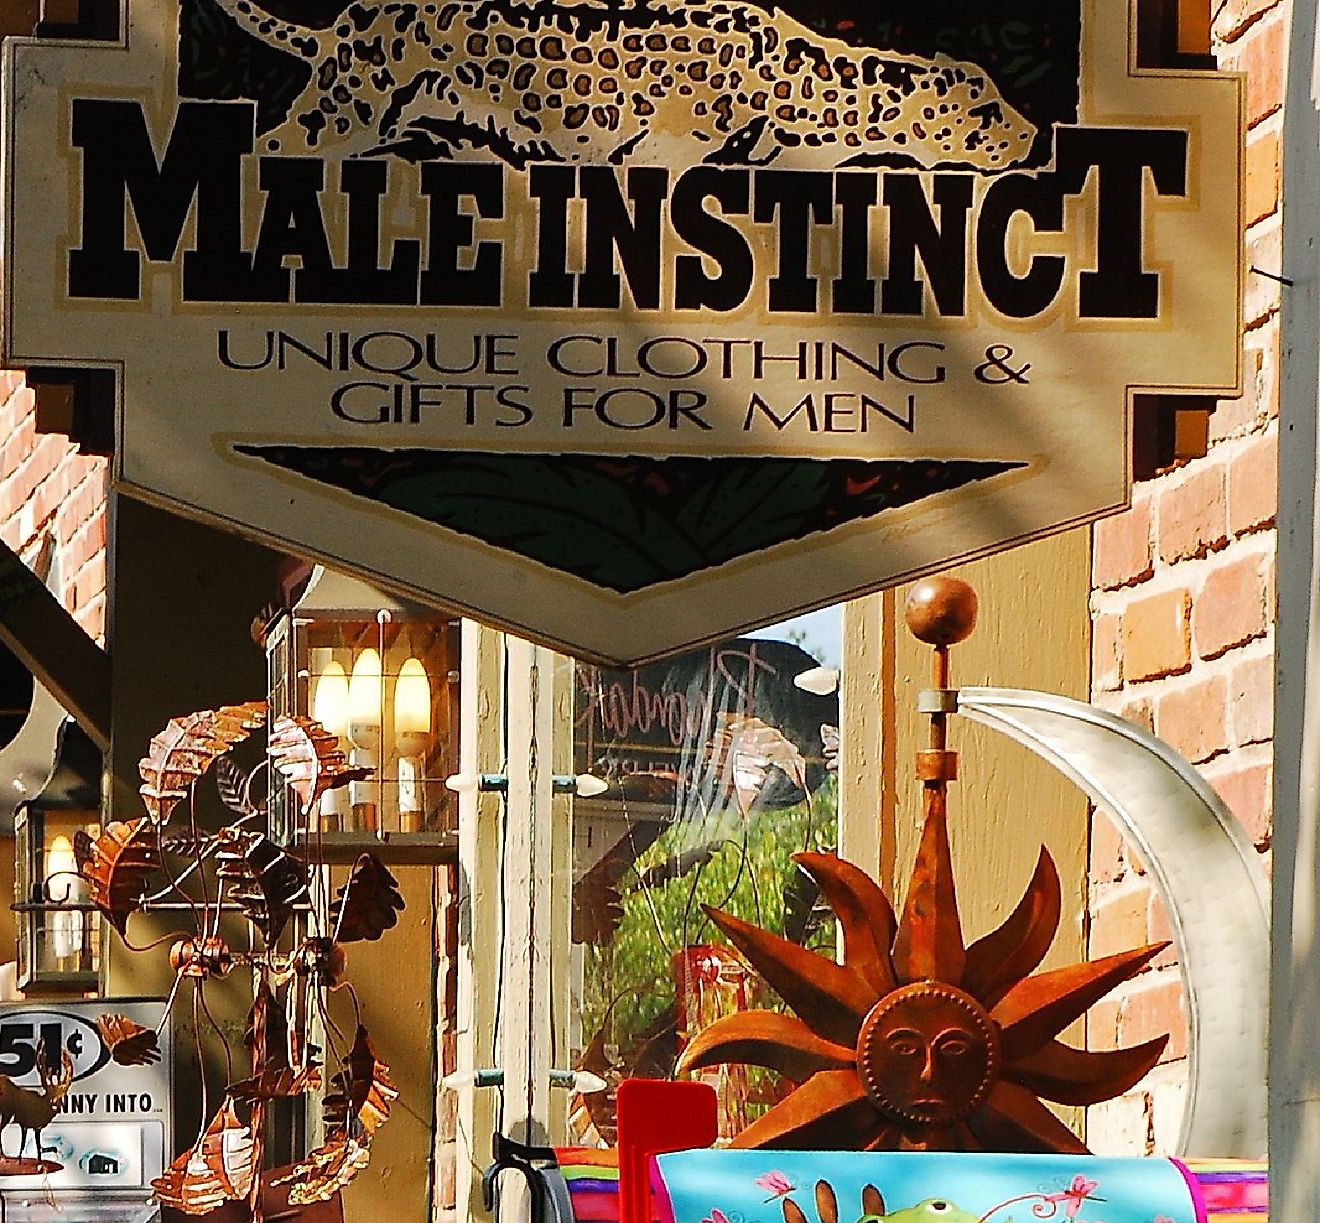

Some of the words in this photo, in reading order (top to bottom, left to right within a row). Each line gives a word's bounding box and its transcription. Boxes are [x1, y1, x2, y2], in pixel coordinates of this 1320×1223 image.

[68, 99, 503, 307] MALE
[528, 129, 1189, 319] INSTINCT
[217, 330, 519, 381] UNIQUE
[547, 336, 946, 385] CLOTHING
[974, 343, 1032, 385] &
[331, 382, 534, 428] GIFTS
[564, 387, 714, 431] FOR
[743, 394, 915, 433] MEN
